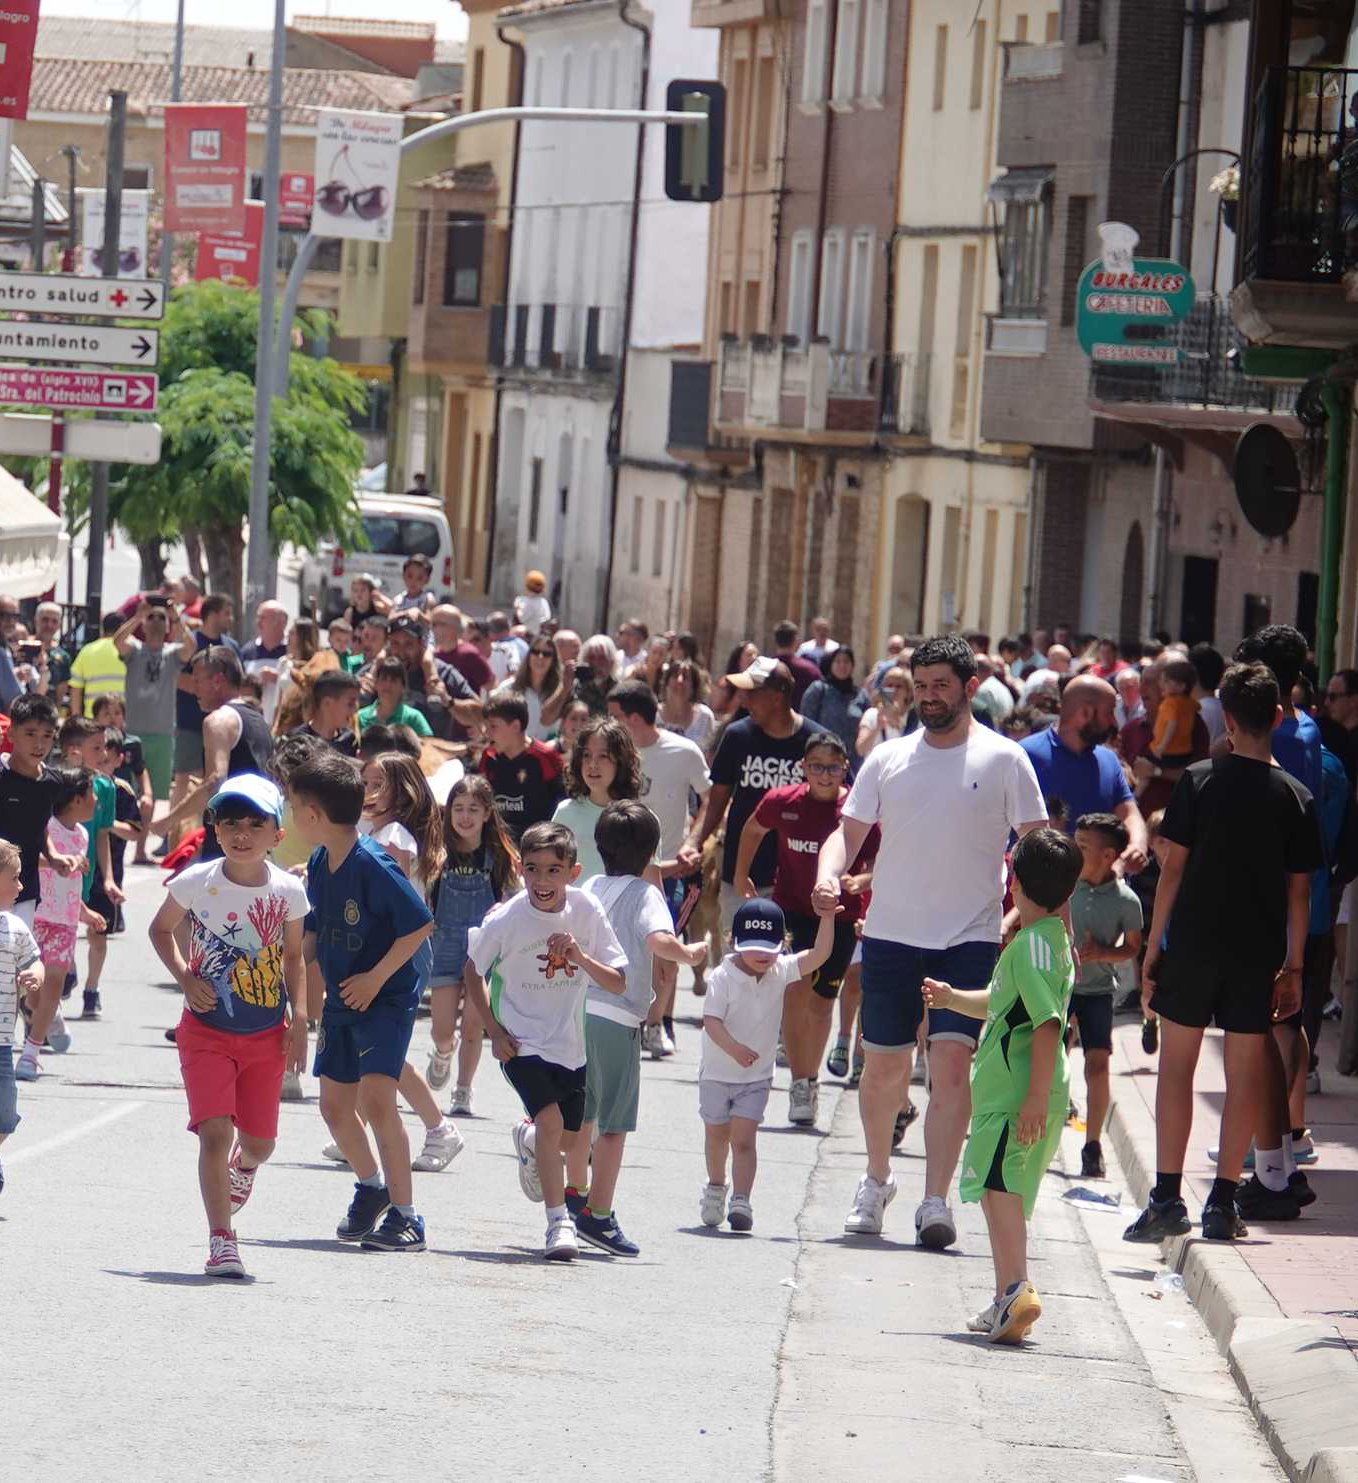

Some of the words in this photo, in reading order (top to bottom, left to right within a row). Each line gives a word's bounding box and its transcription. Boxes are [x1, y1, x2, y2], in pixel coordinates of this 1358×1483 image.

[47, 288, 99, 303] salud
[25, 387, 41, 400] del
[787, 838, 819, 853] NIKE
[745, 919, 772, 930] BOSS
